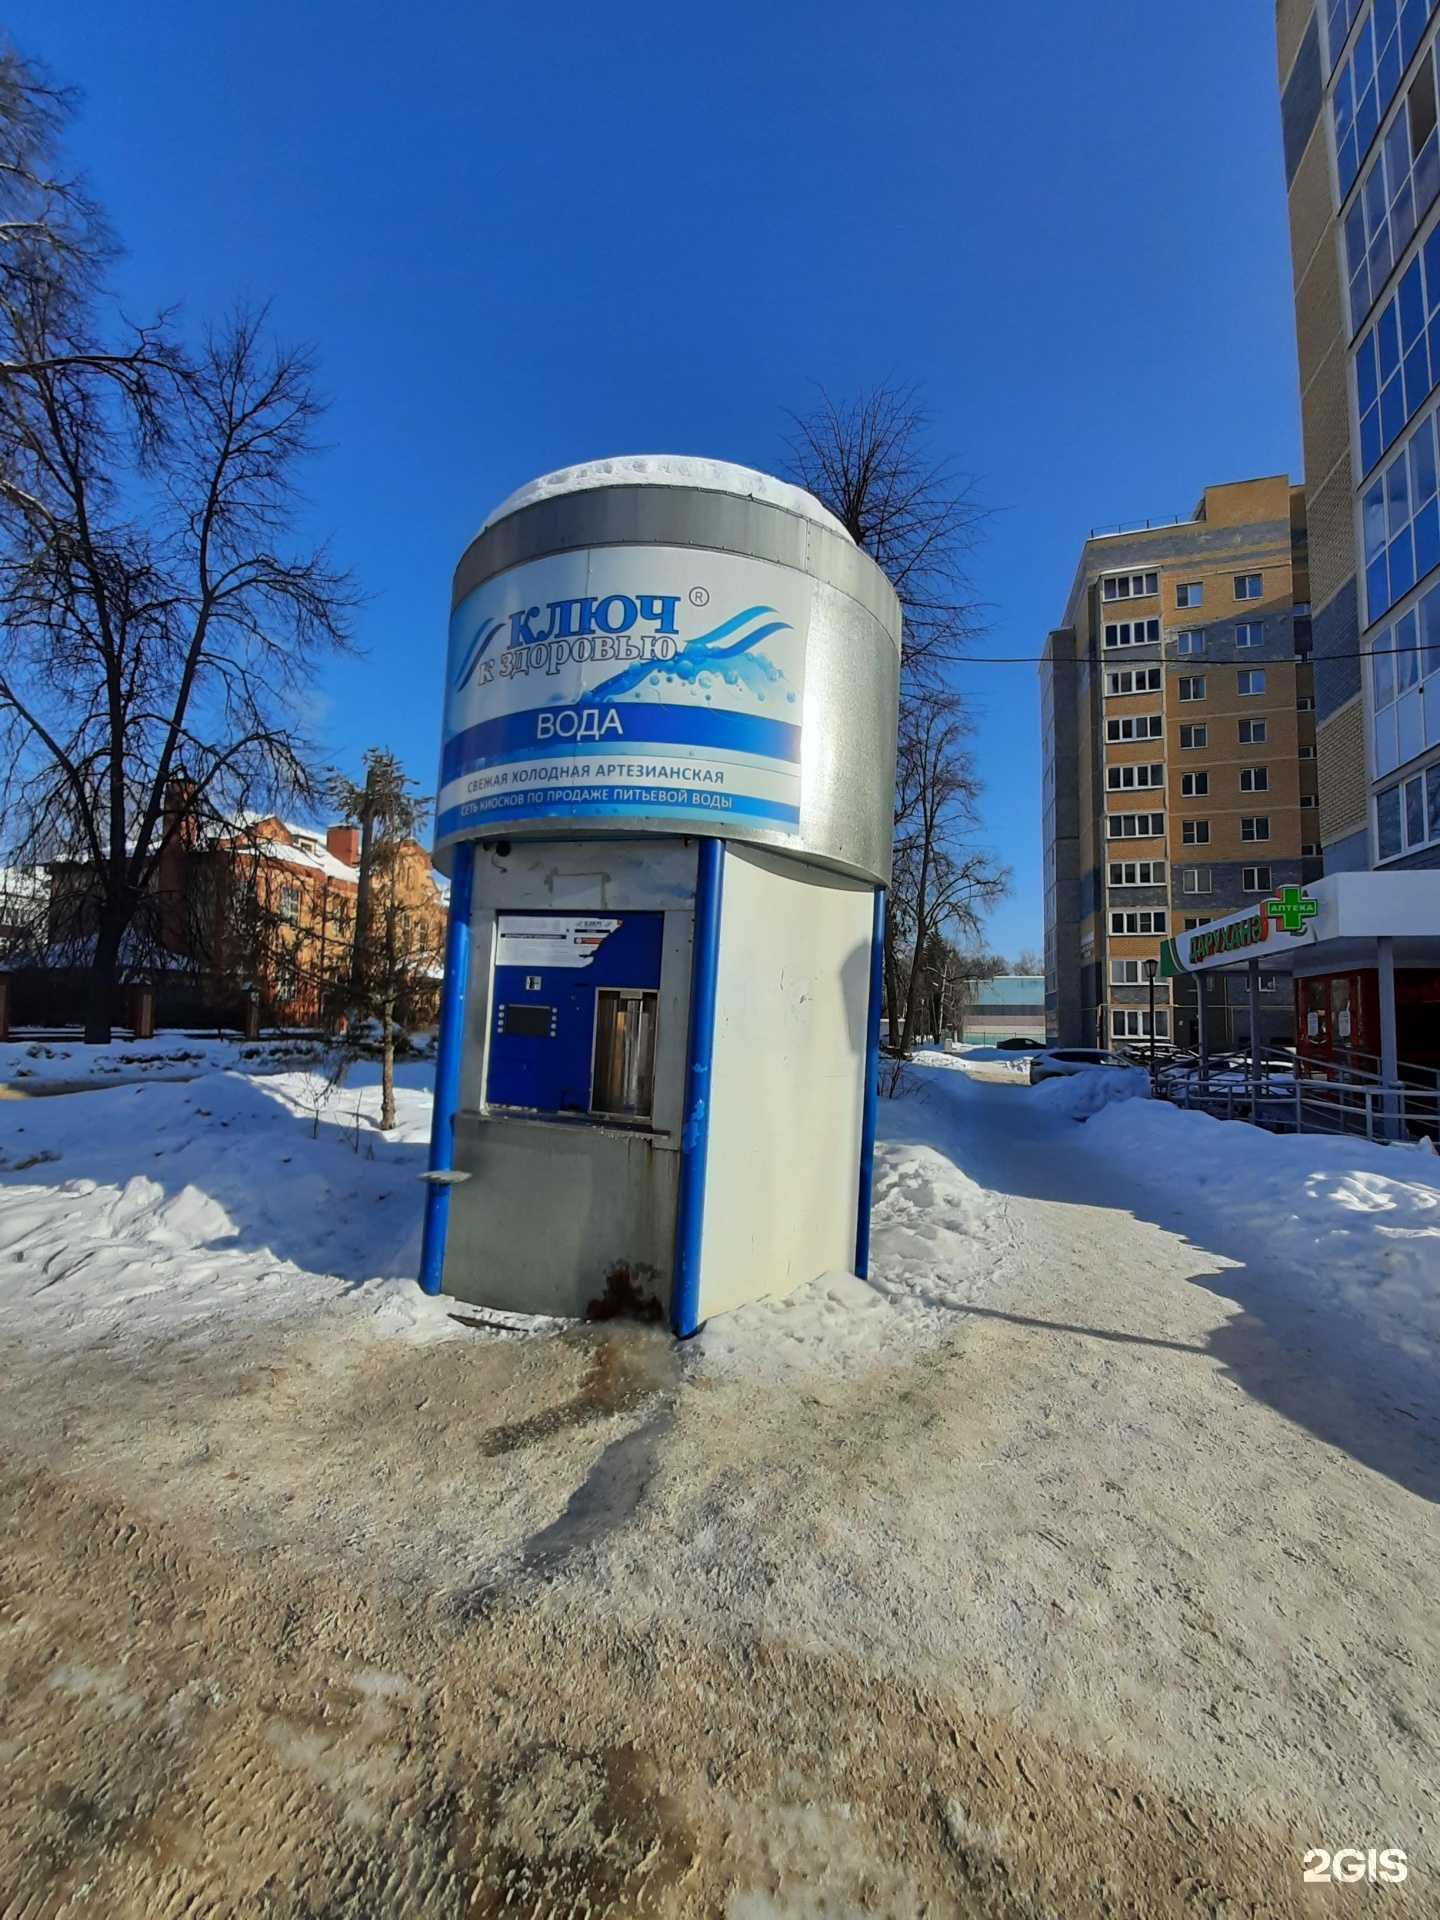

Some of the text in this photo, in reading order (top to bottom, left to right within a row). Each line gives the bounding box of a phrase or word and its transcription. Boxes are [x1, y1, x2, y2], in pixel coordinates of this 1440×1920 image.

[536, 708, 624, 741] ВОДА
[466, 764, 724, 794] СВЕЖАЯ ХОЛОДНАЯ АРТЕЗИАНСКАЯ
[460, 788, 733, 817] СЕТЬ КИОСКОВ ПО ПРОДАЖЕ ПИТЬЕВОЙ ВОДЫ
[1270, 903, 1314, 912] АПТЕКА
